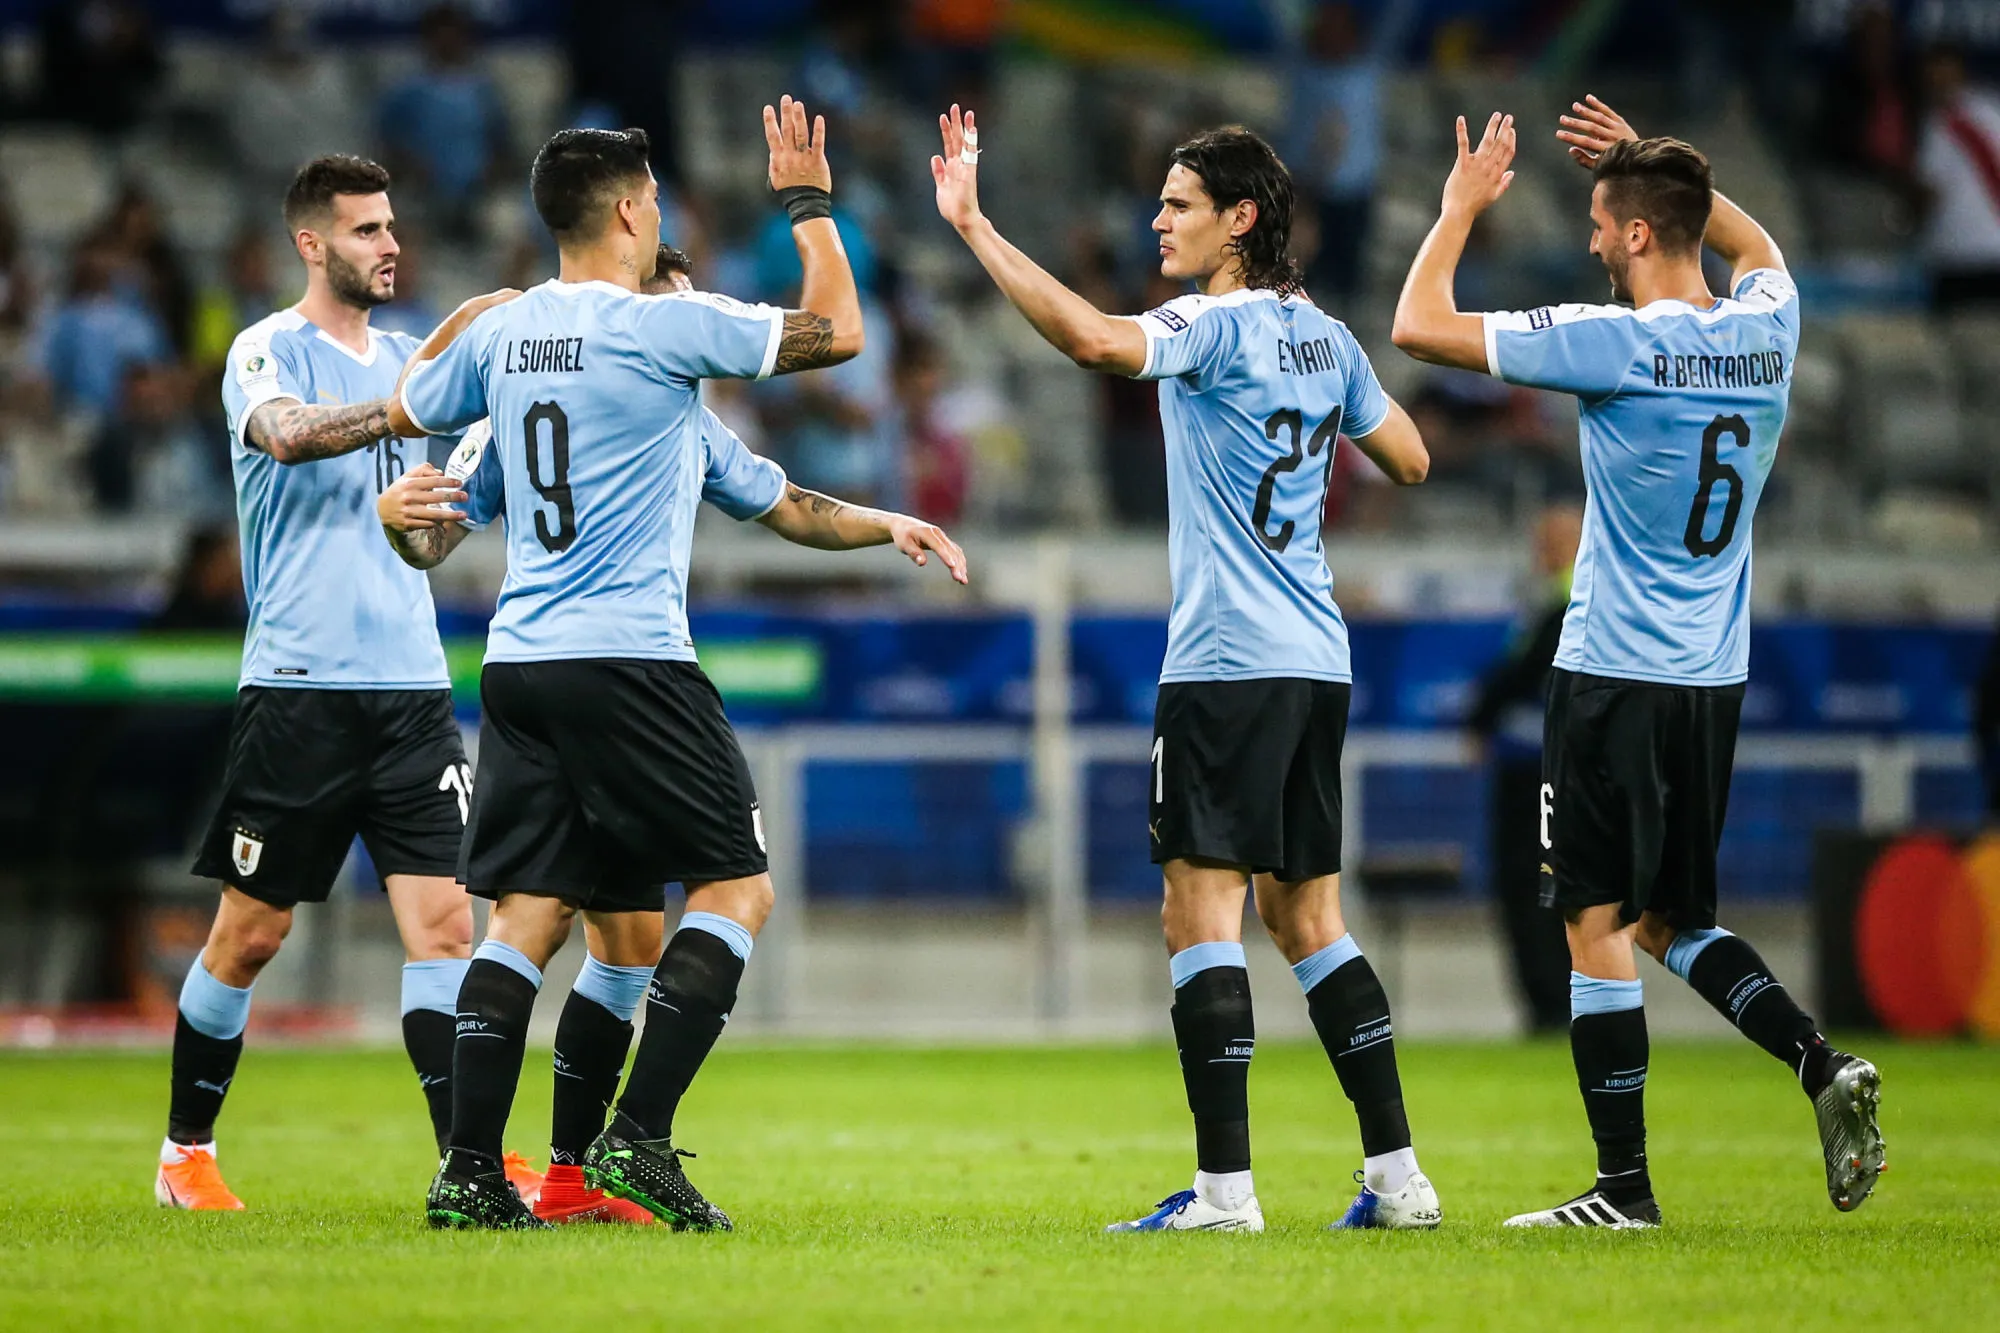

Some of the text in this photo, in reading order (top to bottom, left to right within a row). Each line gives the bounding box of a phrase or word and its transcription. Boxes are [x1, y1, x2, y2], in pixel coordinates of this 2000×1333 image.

[505, 333, 585, 374] L.SUÁREZ
[1278, 337, 1336, 376] E.VANI
[1653, 350, 1785, 388] R.BENTANCUR
[523, 401, 577, 554] 9
[1252, 405, 1342, 554] 21
[1683, 413, 1750, 558] 6
